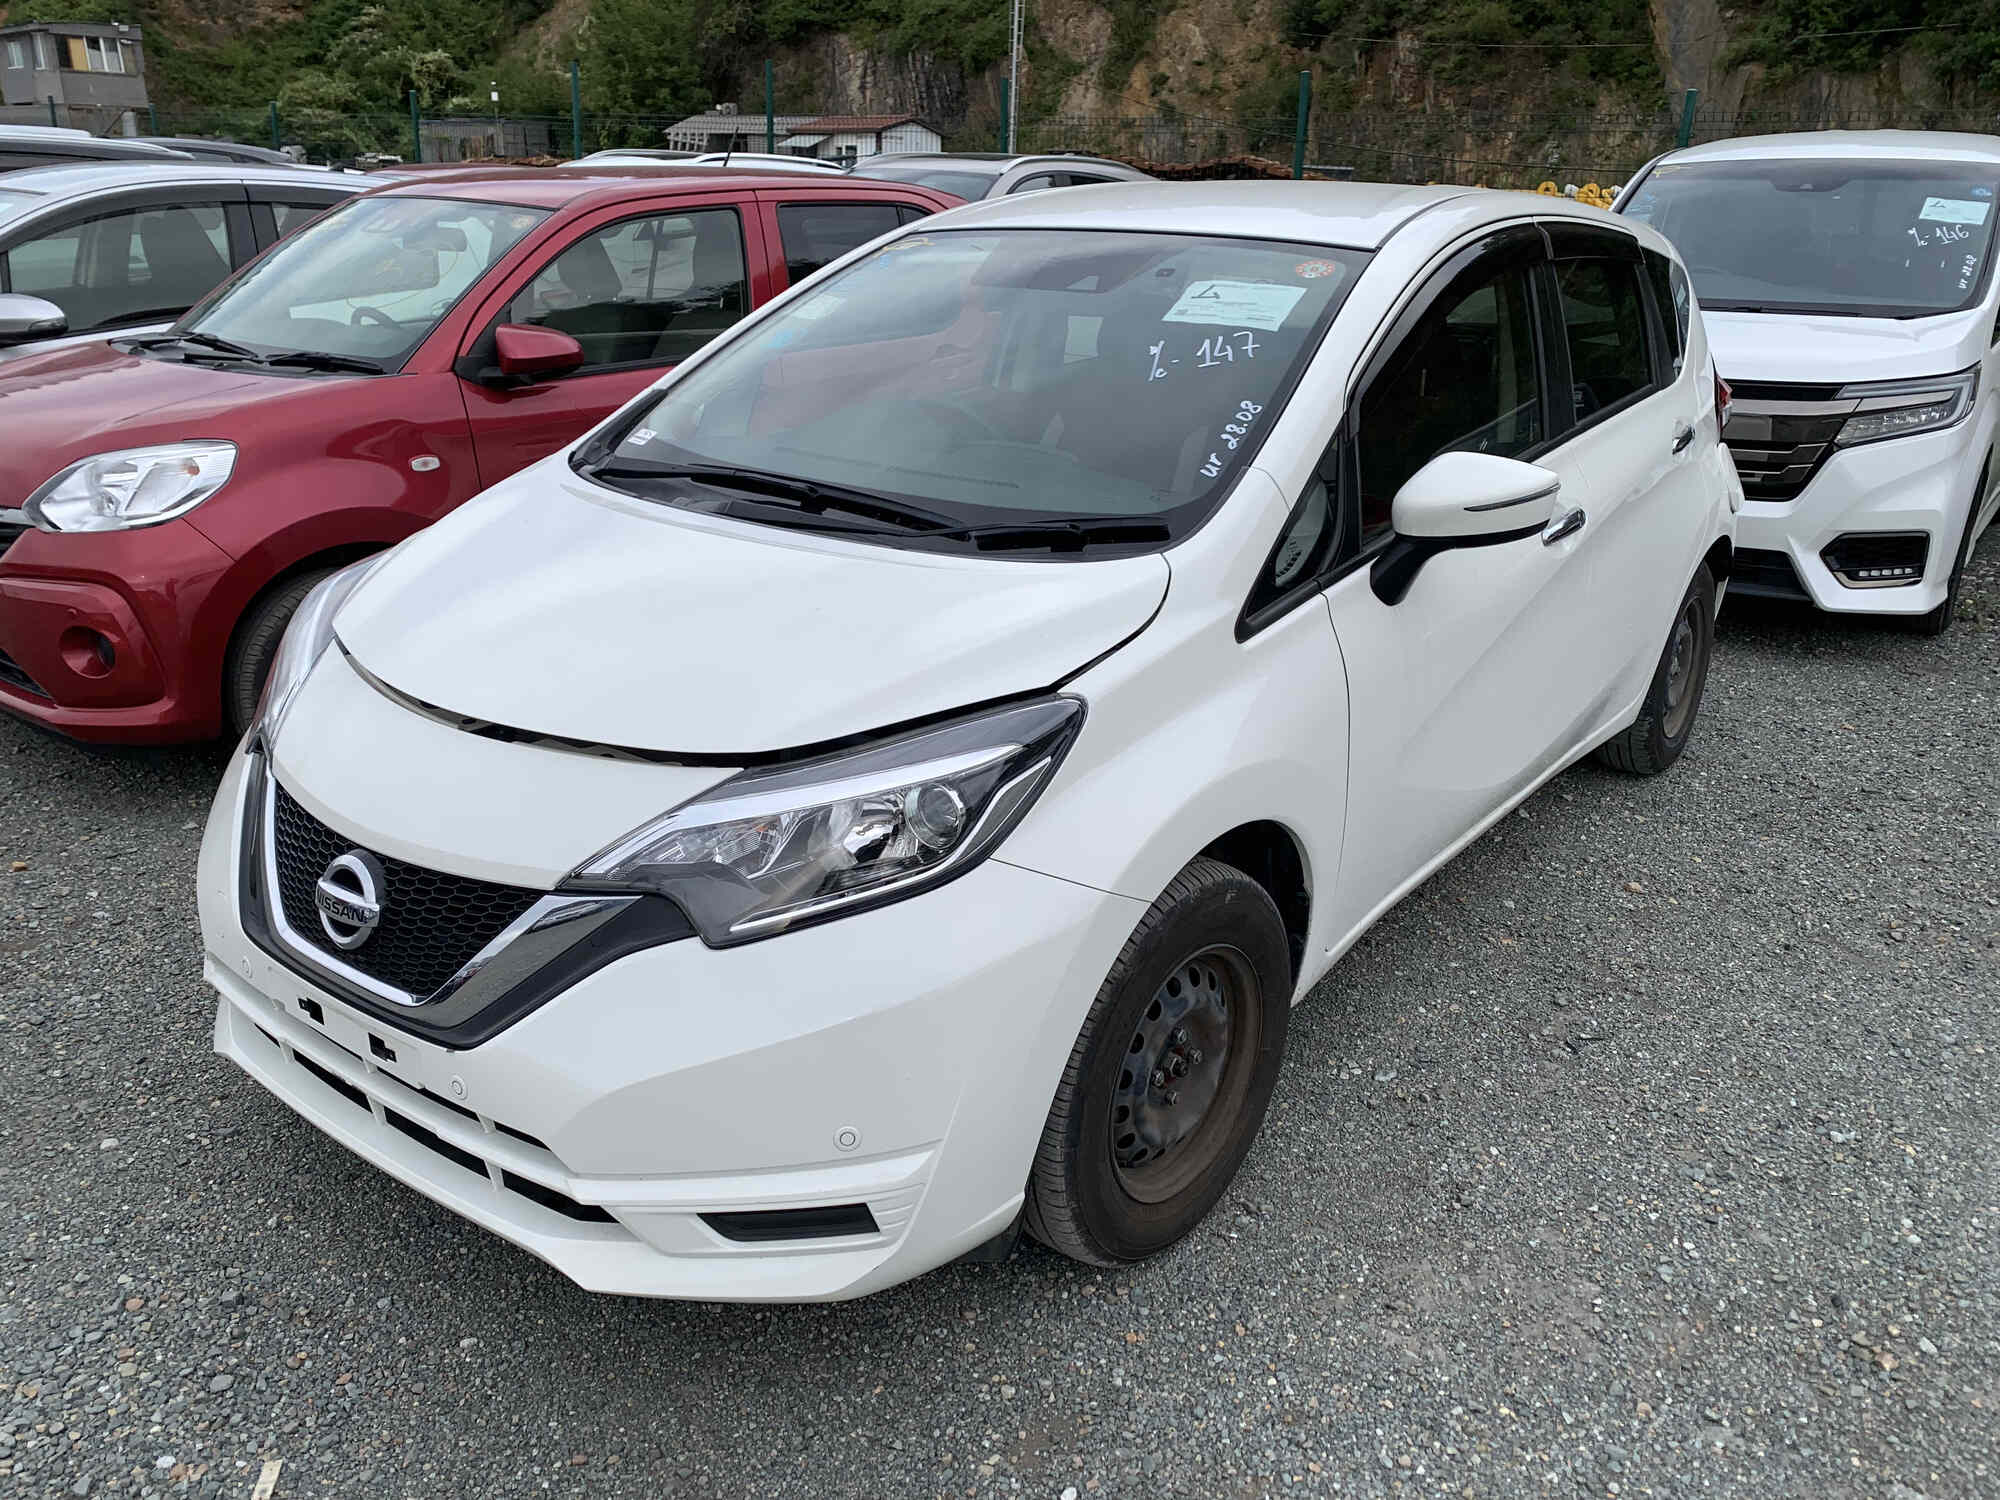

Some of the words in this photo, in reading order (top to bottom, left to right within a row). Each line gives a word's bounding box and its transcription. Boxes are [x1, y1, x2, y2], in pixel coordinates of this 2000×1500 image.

[1935, 224, 1969, 245] 146
[1196, 331, 1260, 367] 147
[1220, 400, 1262, 450] 28.08
